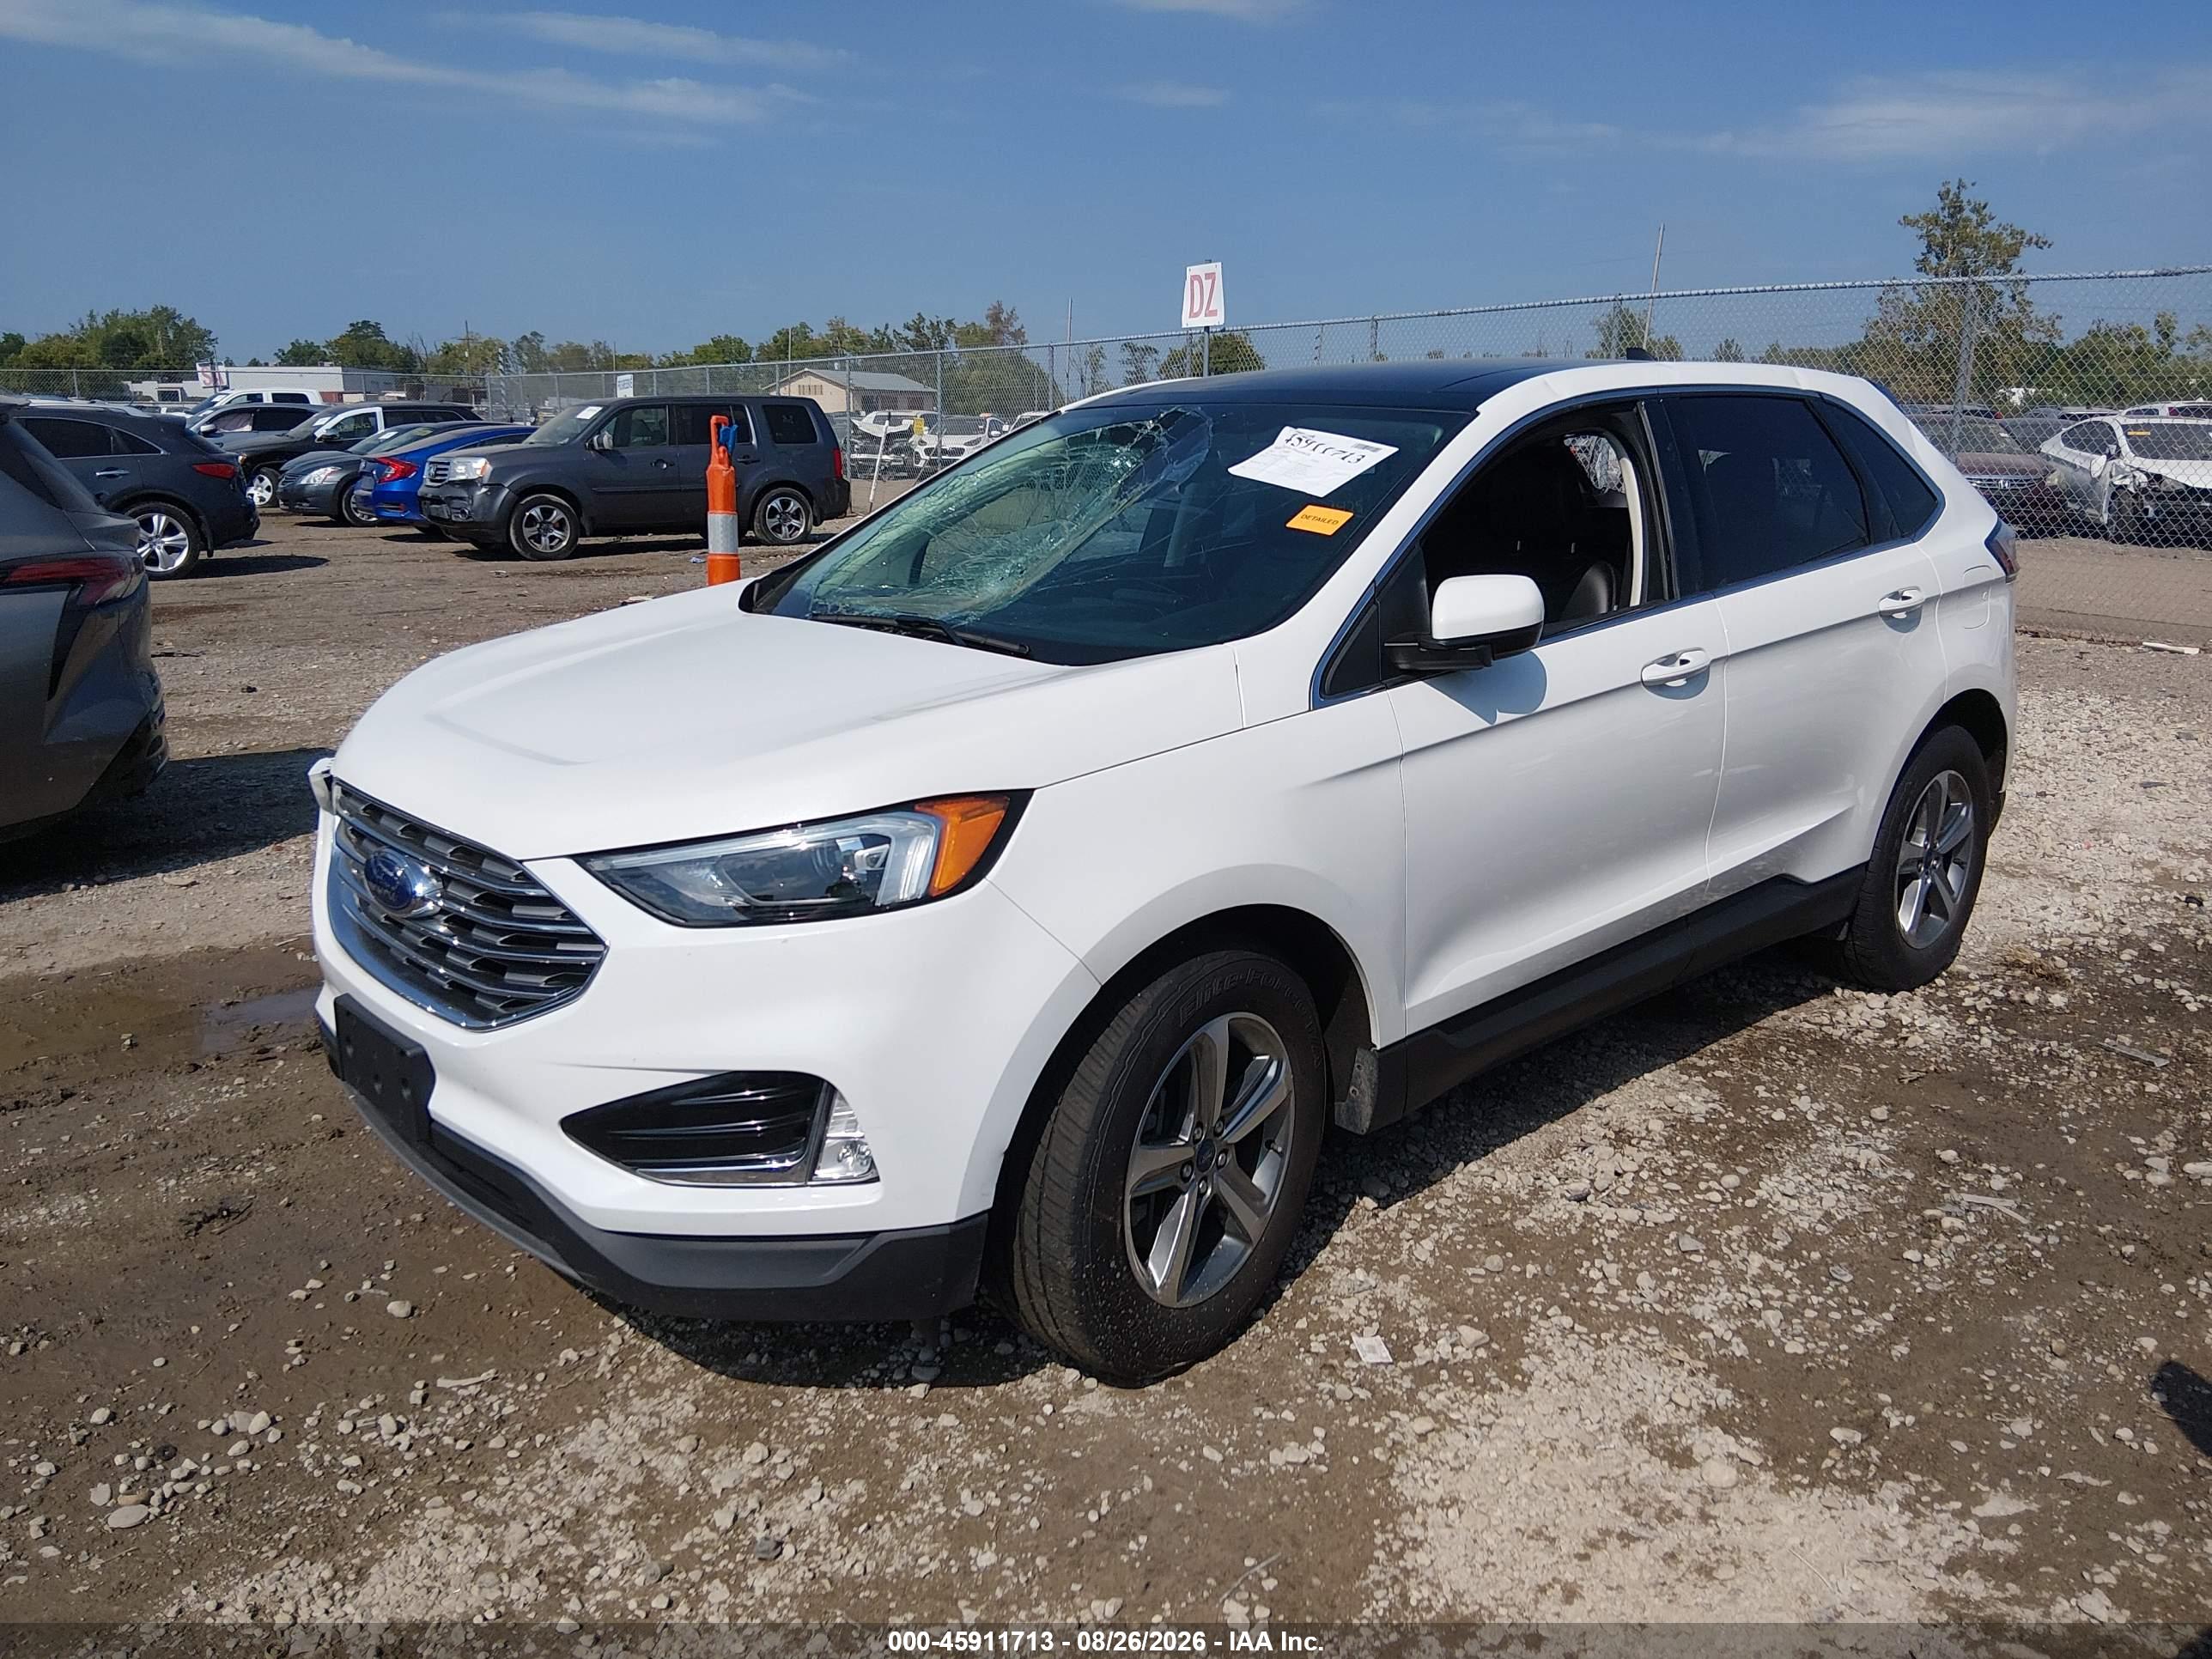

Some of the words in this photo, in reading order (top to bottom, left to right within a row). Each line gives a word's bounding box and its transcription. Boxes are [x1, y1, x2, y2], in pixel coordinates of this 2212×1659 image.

[1188, 272, 1218, 319] DZ
[1284, 432, 1367, 465] 45911713
[1300, 514, 1340, 526] DETAILED
